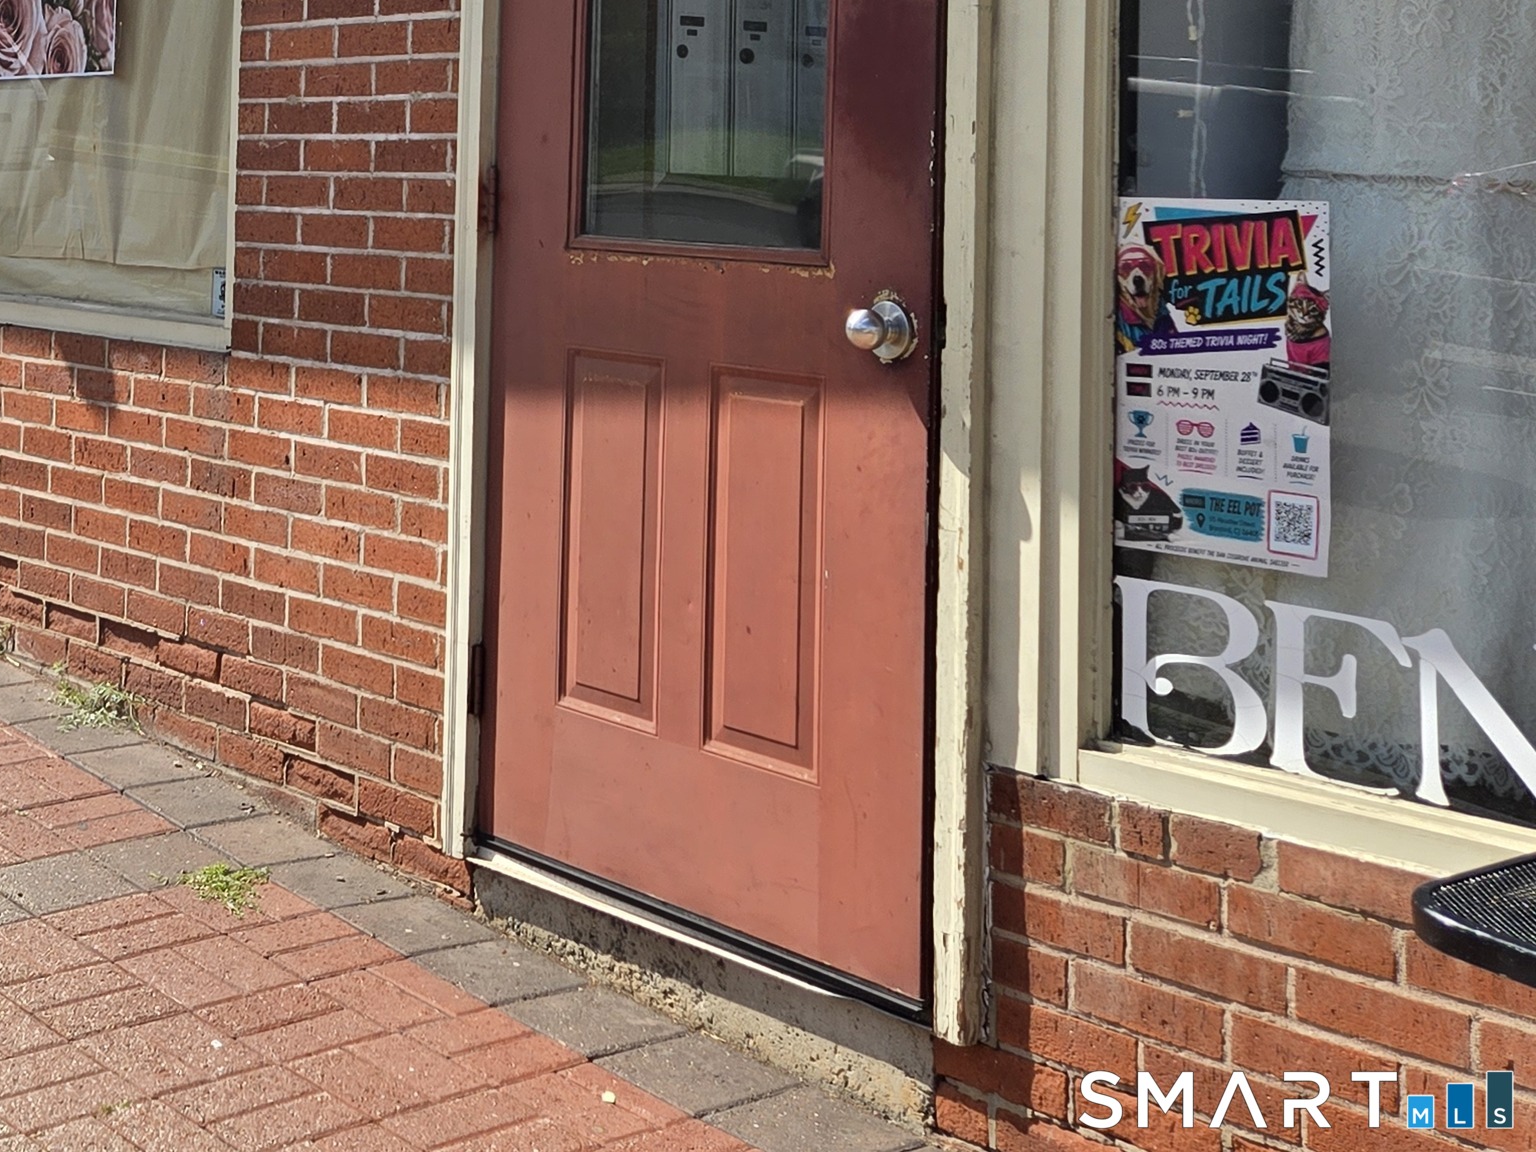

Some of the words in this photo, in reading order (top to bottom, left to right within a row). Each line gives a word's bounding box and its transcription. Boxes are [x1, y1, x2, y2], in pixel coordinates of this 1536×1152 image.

[1149, 216, 1303, 278] TRIVIA
[1168, 278, 1193, 304] for
[1196, 271, 1287, 319] TAILS
[1150, 337, 1167, 350] 80s
[1169, 336, 1203, 349] THEMED
[1205, 335, 1234, 347] TRIVIA
[1236, 333, 1269, 346] NIGHT!
[1158, 367, 1192, 382] MONDAY,
[1194, 369, 1239, 382] SEPTEMBER
[1157, 385, 1164, 396] 6
[1167, 385, 1181, 397] PM
[1192, 387, 1199, 398] 9
[1202, 388, 1215, 399] PM
[1209, 496, 1226, 513] THE
[1227, 498, 1242, 515] EEL
[1244, 501, 1262, 517] POT
